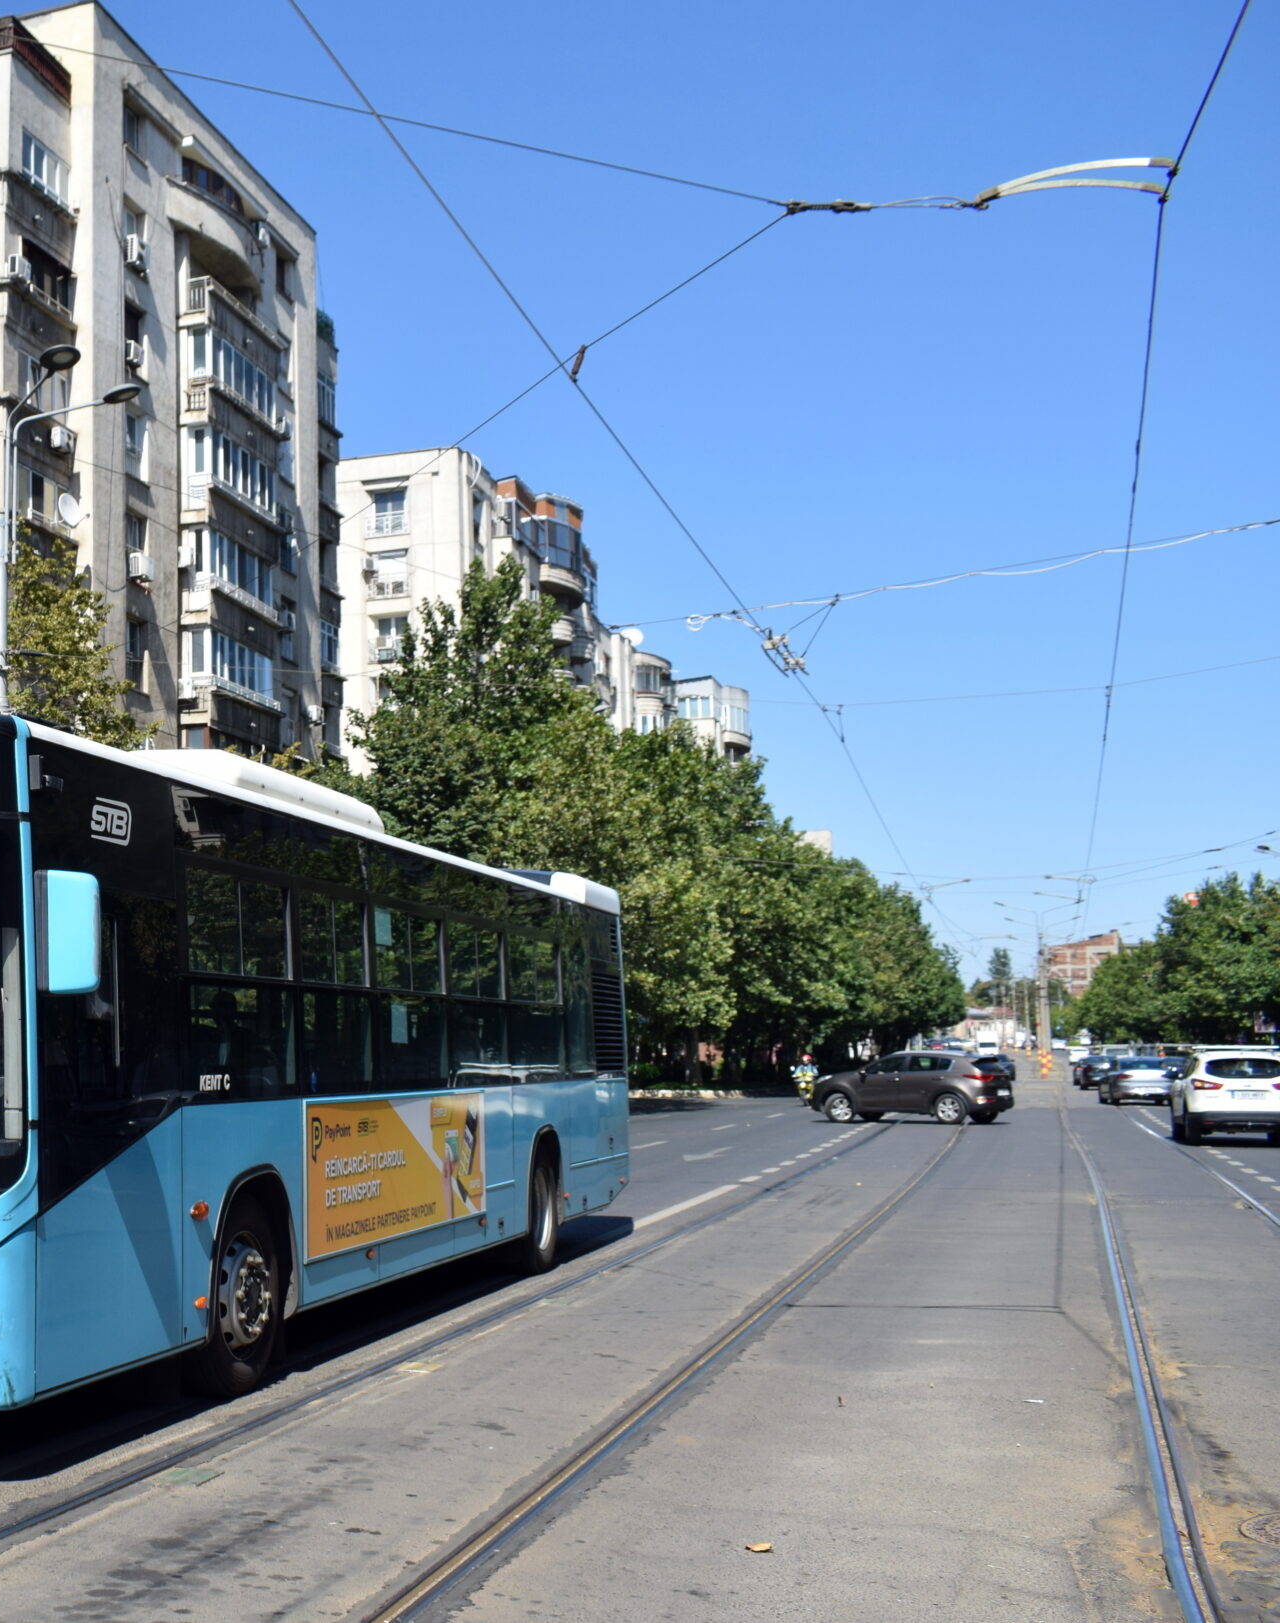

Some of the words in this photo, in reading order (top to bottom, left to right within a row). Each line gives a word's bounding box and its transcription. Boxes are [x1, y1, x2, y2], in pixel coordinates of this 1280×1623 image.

[90, 803, 128, 838] STB
[200, 1074, 222, 1091] KENT
[223, 1074, 230, 1090] C
[325, 1123, 351, 1141] PayPoint
[378, 1149, 406, 1168] CARDUL
[325, 1188, 336, 1208] DE
[337, 1180, 381, 1204] TRANSPORT
[335, 1216, 376, 1240] MAGAZINELE
[377, 1208, 410, 1229] PARTENERE
